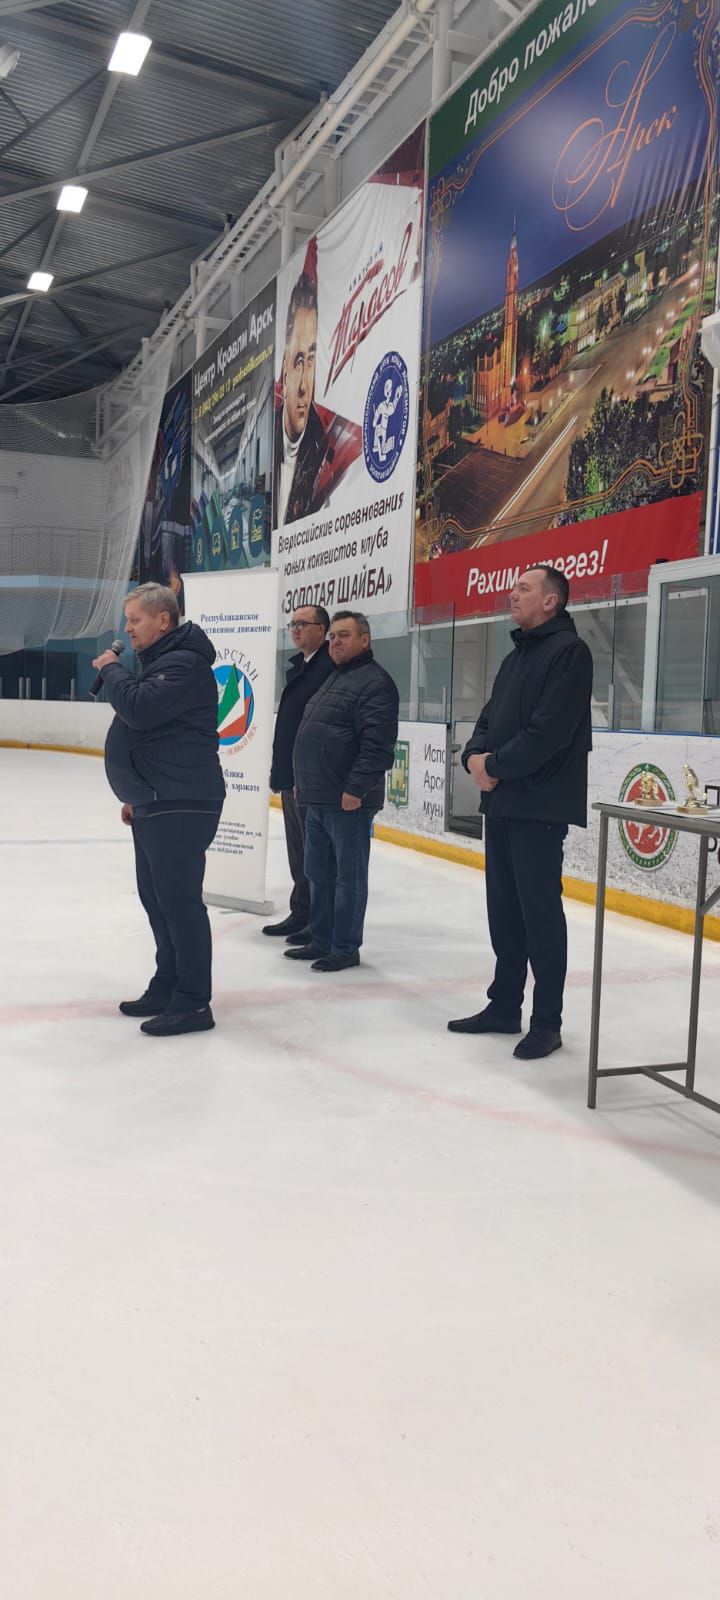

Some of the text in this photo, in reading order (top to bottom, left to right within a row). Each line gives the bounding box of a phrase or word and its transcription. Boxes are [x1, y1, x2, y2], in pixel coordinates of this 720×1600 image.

[464, 57, 519, 135] Добро
[194, 362, 216, 397] Центр
[217, 329, 248, 376] Кровли
[249, 303, 273, 344] Арск
[278, 492, 404, 554] Всероссийские соревнования
[284, 526, 389, 577] юных хоккеистов клуба
[466, 539, 609, 597] Рәхим егез!
[337, 563, 393, 604] ШАЙБА»
[200, 613, 259, 624] Республиканское
[215, 648, 259, 682] АРСТАН
